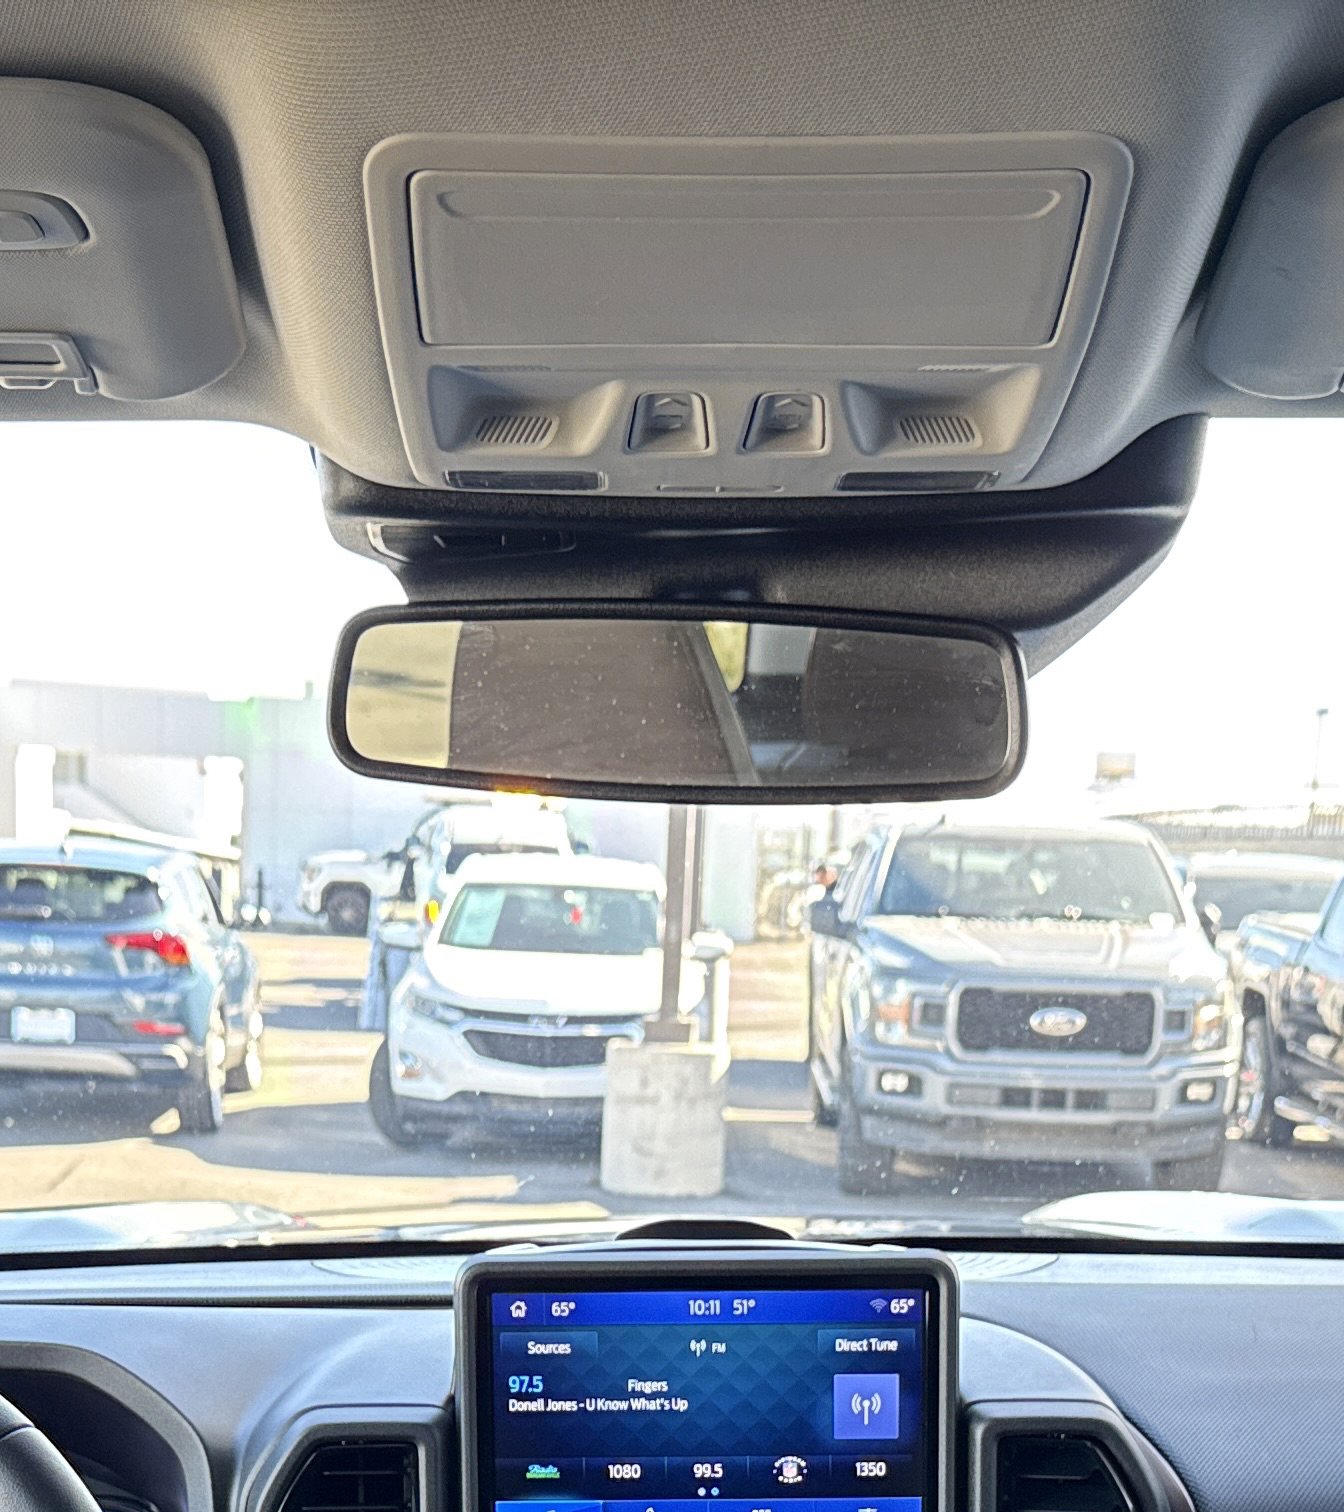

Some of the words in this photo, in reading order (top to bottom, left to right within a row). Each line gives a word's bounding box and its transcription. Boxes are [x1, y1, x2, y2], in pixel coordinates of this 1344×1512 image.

[688, 1299, 721, 1316] 10:11
[527, 1341, 572, 1355] Sources
[711, 1343, 727, 1354] FM
[835, 1338, 868, 1352] Direct
[869, 1338, 898, 1351] Tune
[508, 1376, 544, 1393] 97.5
[627, 1379, 669, 1394] Fingers
[509, 1398, 545, 1412] Donell
[546, 1399, 578, 1412] Jones
[586, 1398, 596, 1411] U
[597, 1398, 629, 1411] Know
[630, 1397, 670, 1411] What's
[671, 1398, 688, 1412] Up
[608, 1464, 641, 1479] 1080
[693, 1463, 723, 1478] 99.5
[855, 1461, 887, 1477] 1350
